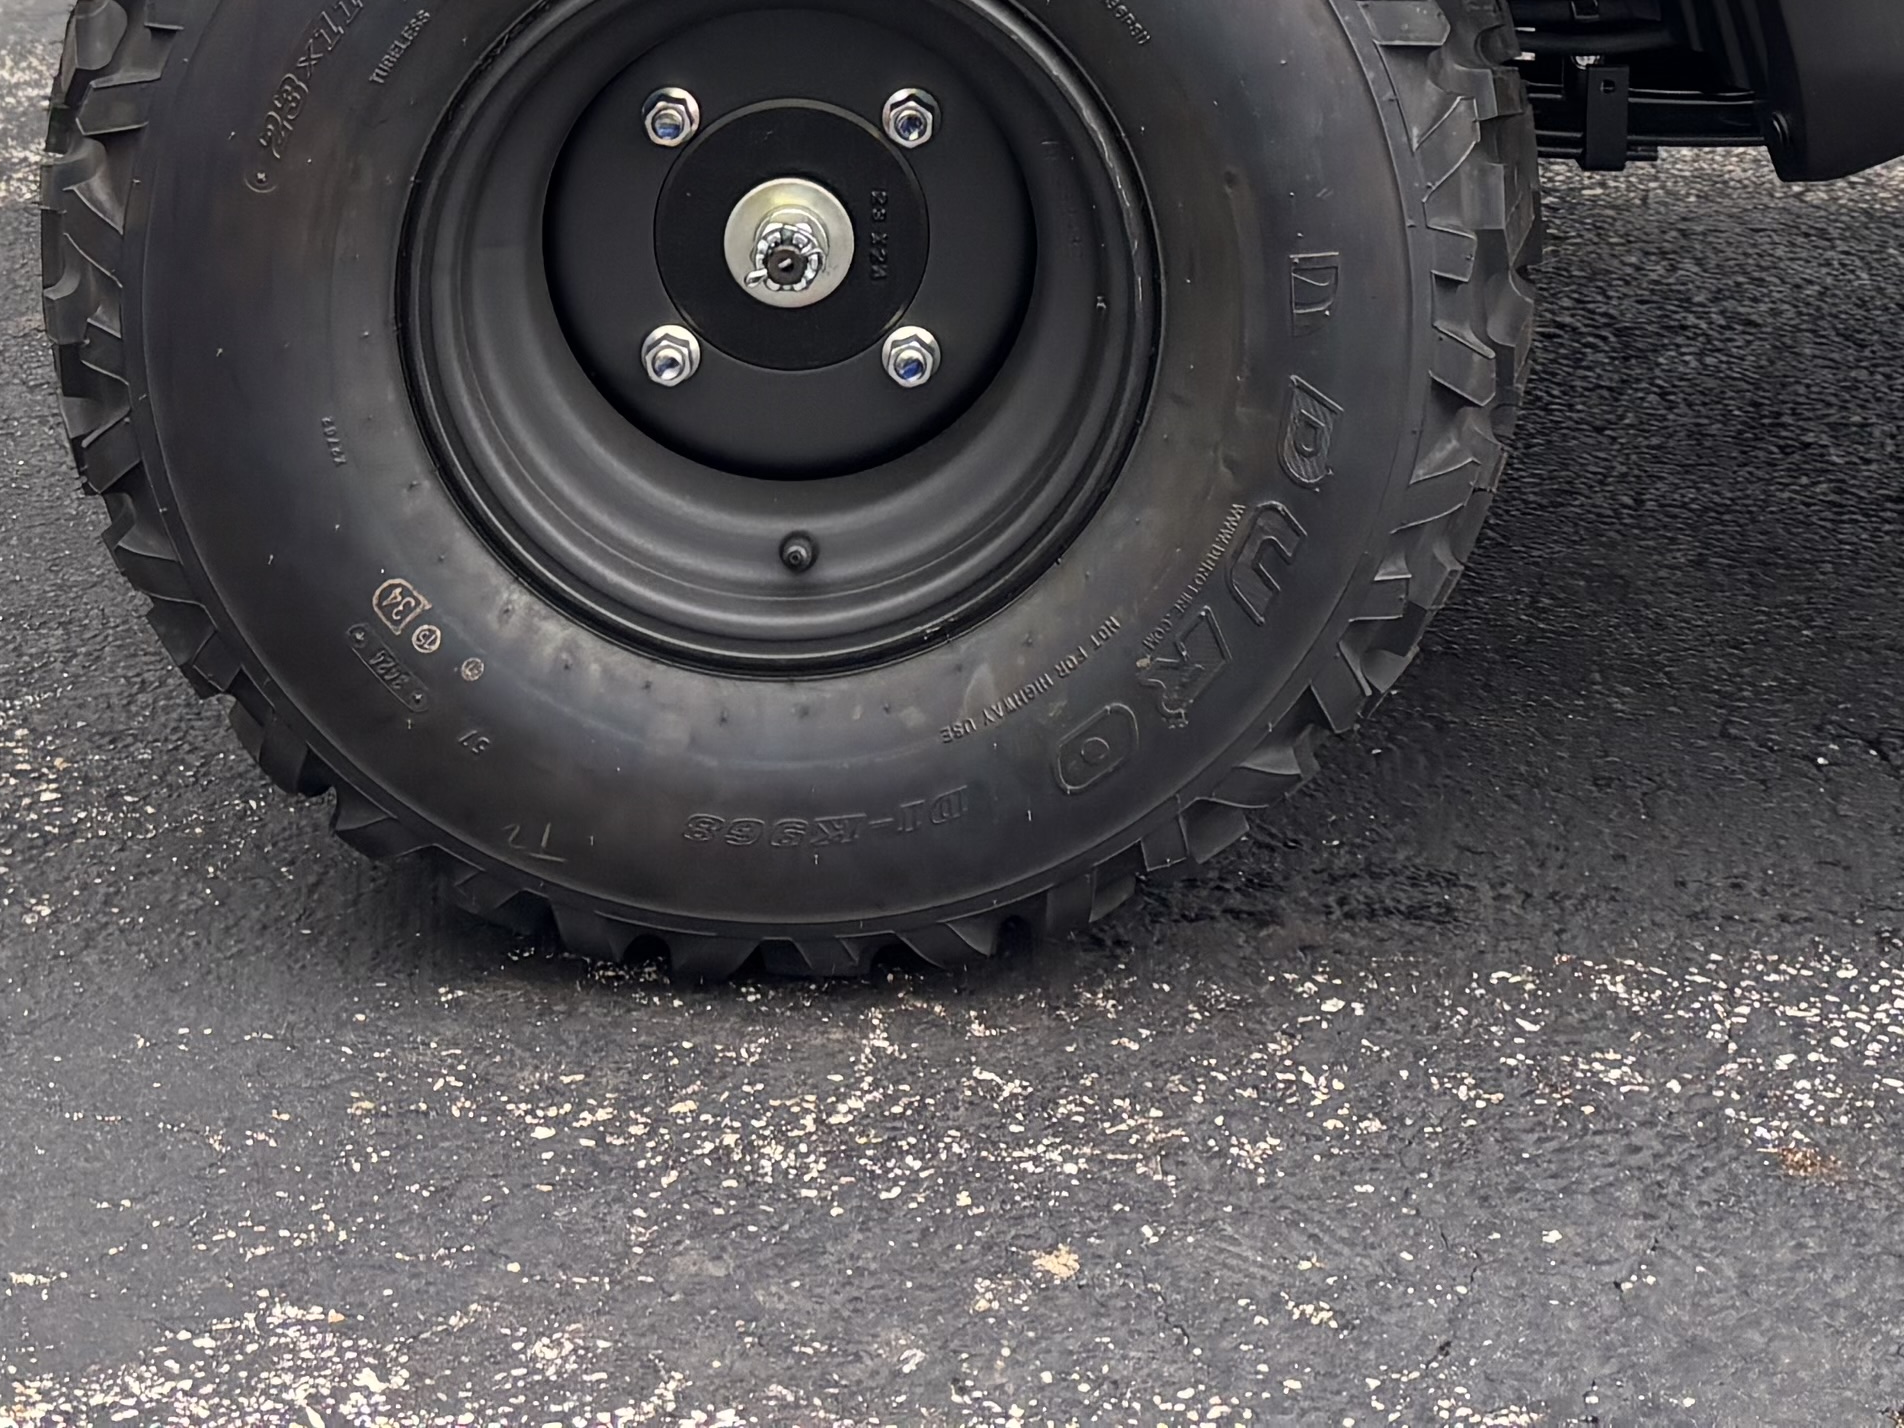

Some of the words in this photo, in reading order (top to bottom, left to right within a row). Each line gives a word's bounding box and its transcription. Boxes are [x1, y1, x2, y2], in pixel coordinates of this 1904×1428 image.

[368, 7, 432, 85] TUBELESS
[1142, 502, 1246, 652] WWW.DUROTIRE.COM
[1090, 613, 1122, 649] NOT
[1055, 644, 1089, 680] FOR
[982, 671, 1055, 729] HIGHWAY
[940, 716, 978, 745] USE
